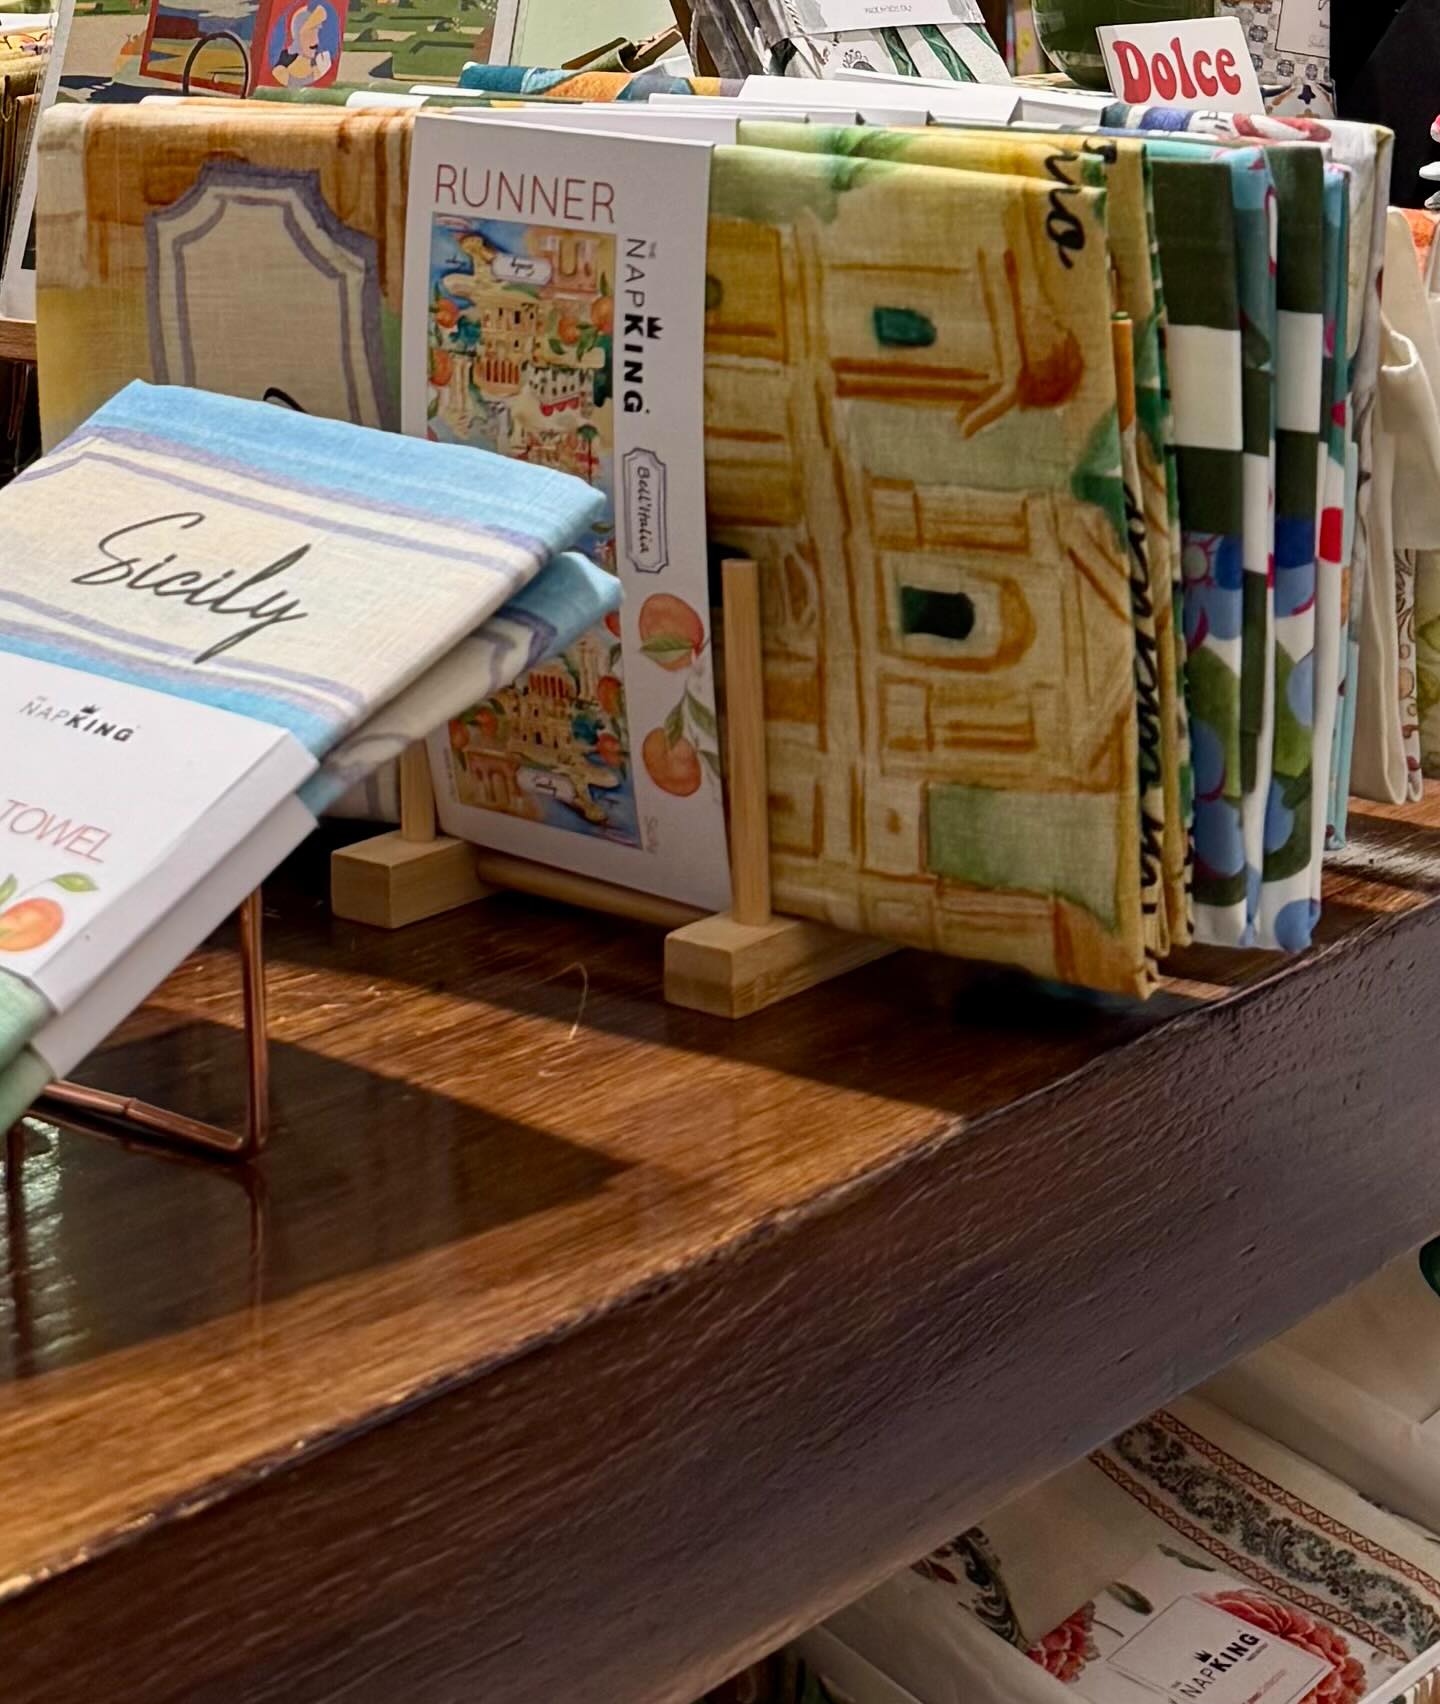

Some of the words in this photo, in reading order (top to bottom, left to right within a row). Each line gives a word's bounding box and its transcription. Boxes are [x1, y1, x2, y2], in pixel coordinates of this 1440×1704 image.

[1112, 36, 1242, 105] Dolce
[434, 163, 616, 224] RUNNER
[623, 237, 647, 414] NAPKING
[635, 465, 652, 555] Bell'Italia
[70, 511, 312, 665] Sicily
[18, 700, 135, 743] NAPKING
[1179, 1632, 1262, 1698] NAPKING
